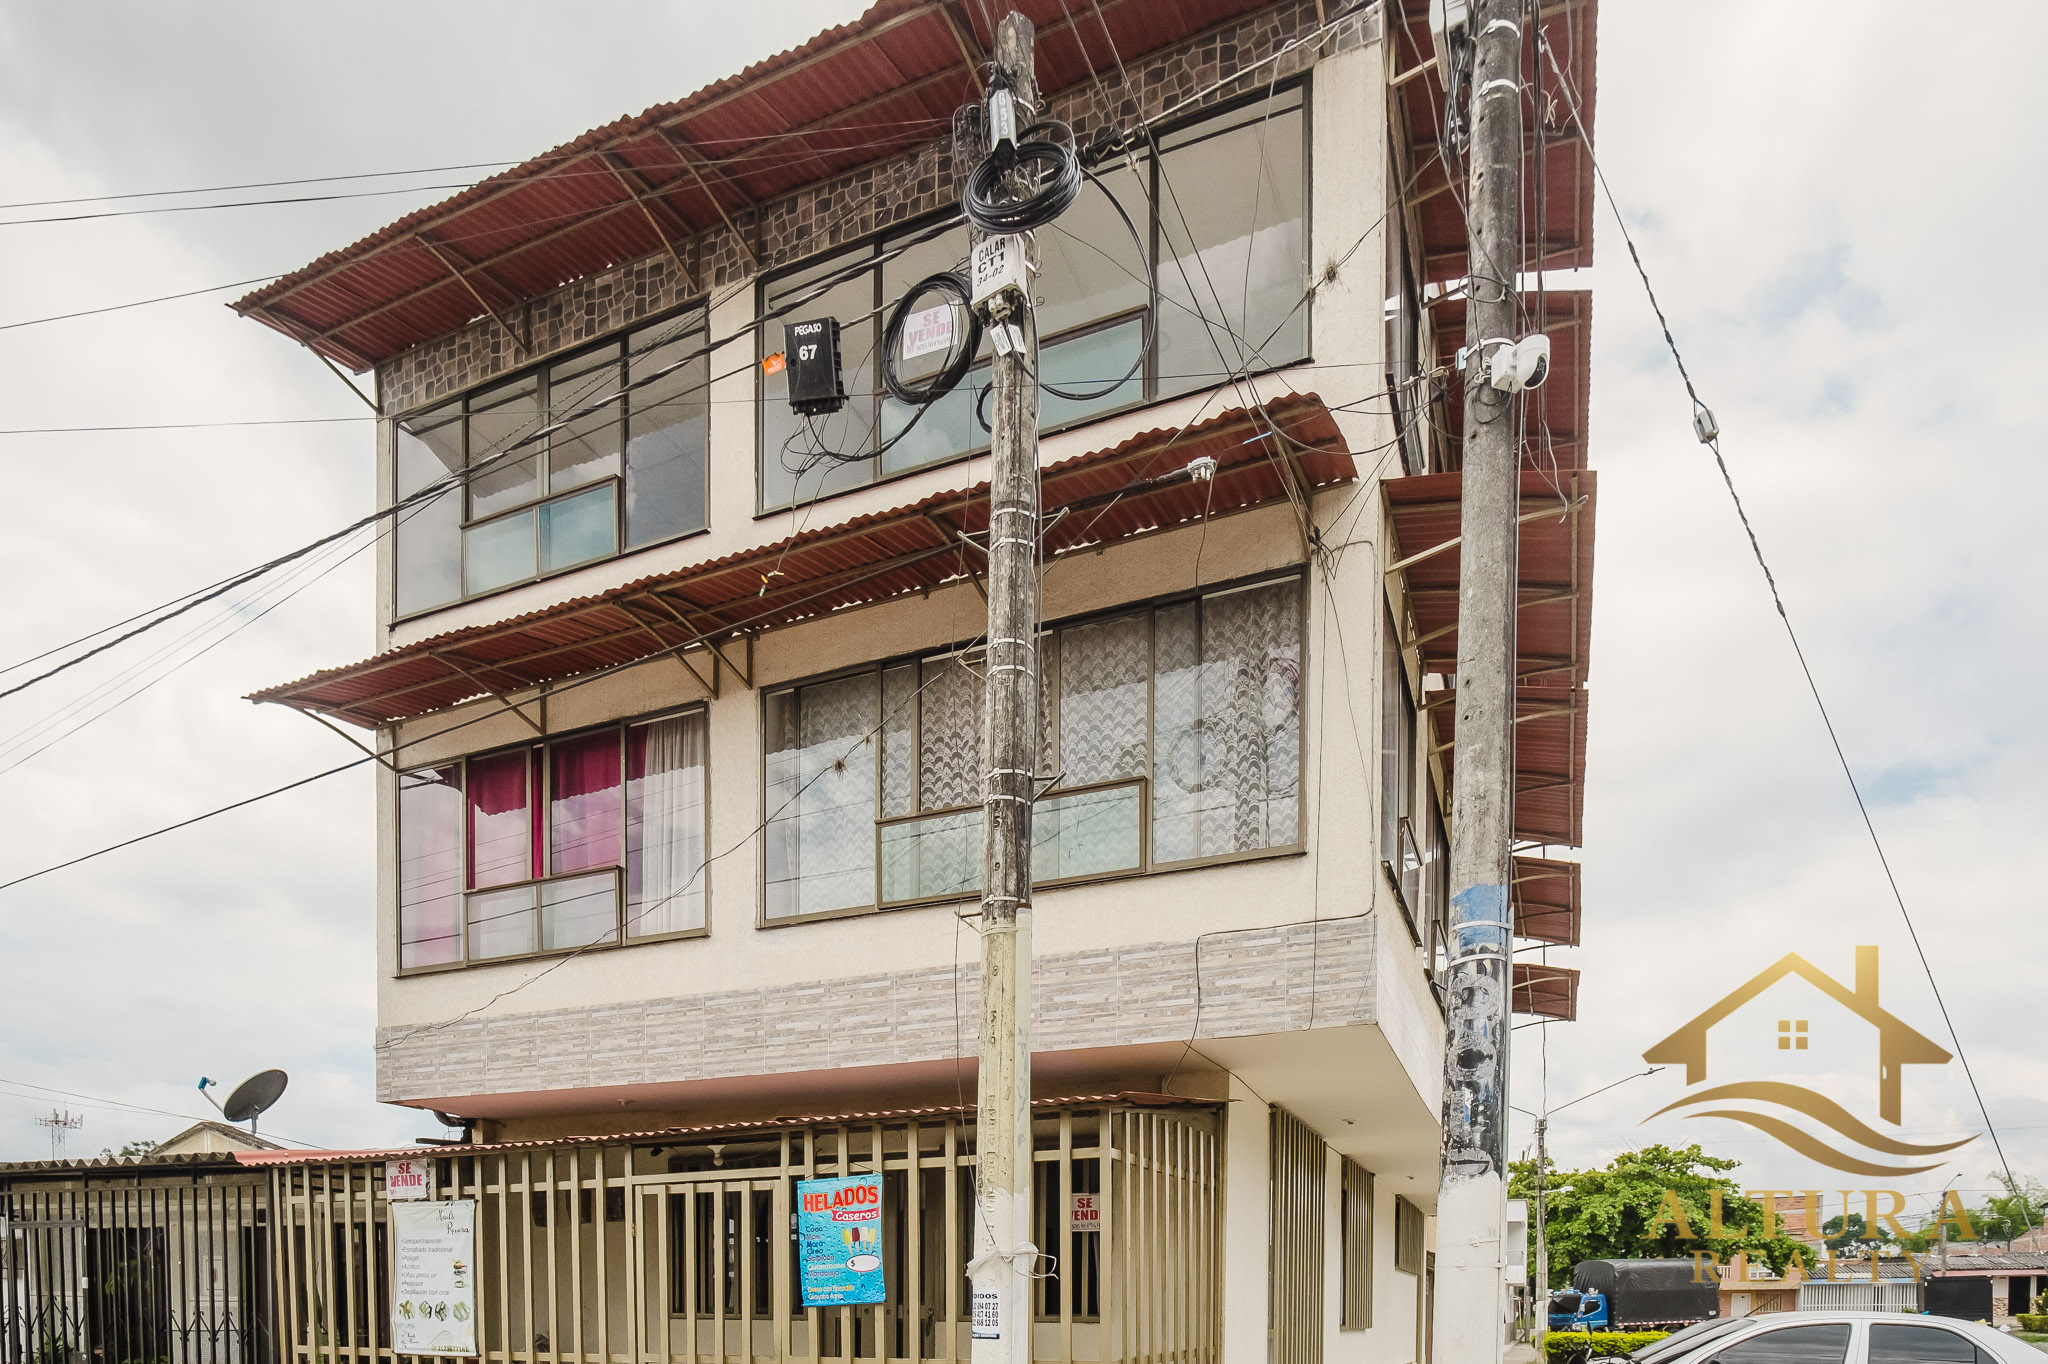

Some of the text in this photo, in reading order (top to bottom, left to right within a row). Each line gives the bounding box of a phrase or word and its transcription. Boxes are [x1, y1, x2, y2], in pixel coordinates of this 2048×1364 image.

[978, 237, 1006, 262] CALAR
[977, 251, 1005, 274] CT1
[923, 311, 940, 328] SE
[794, 322, 822, 337] PEGASO
[799, 344, 818, 361] 67
[398, 1162, 412, 1175] SE
[390, 1174, 423, 1188] VENDE
[802, 1184, 879, 1213] HELADOS
[1077, 1197, 1093, 1208] SE
[835, 1210, 878, 1221] Caseros
[1071, 1210, 1099, 1221] END
[850, 1259, 856, 1268] $
[991, 1302, 999, 1310] 27
[984, 1319, 991, 1327] 12
